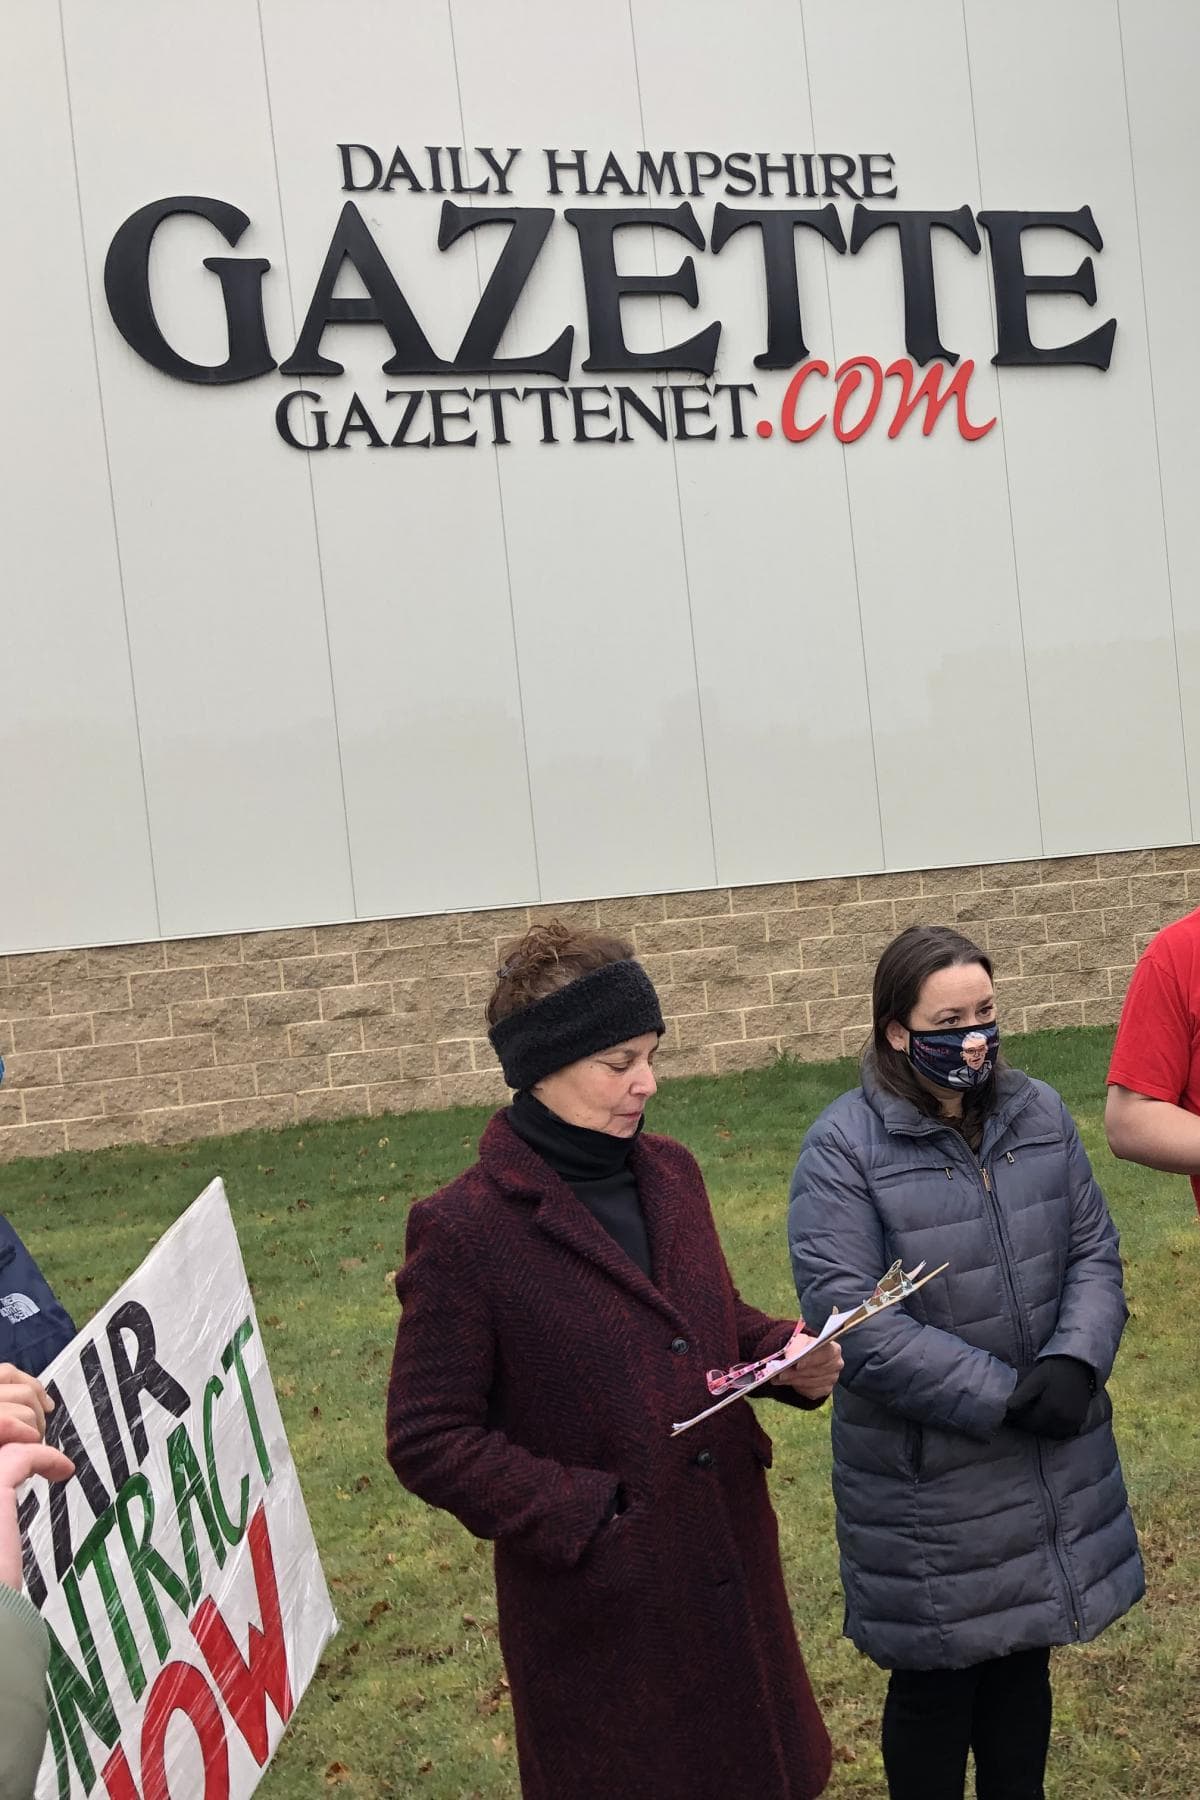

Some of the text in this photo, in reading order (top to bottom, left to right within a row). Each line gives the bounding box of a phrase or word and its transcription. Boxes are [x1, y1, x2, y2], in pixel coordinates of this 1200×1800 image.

[103, 195, 1118, 387] GAZETTE
[336, 143, 898, 202] DAILY HAMPSHIRE
[45, 1316, 273, 1800] NTRACT
[101, 1499, 294, 1800] OW
